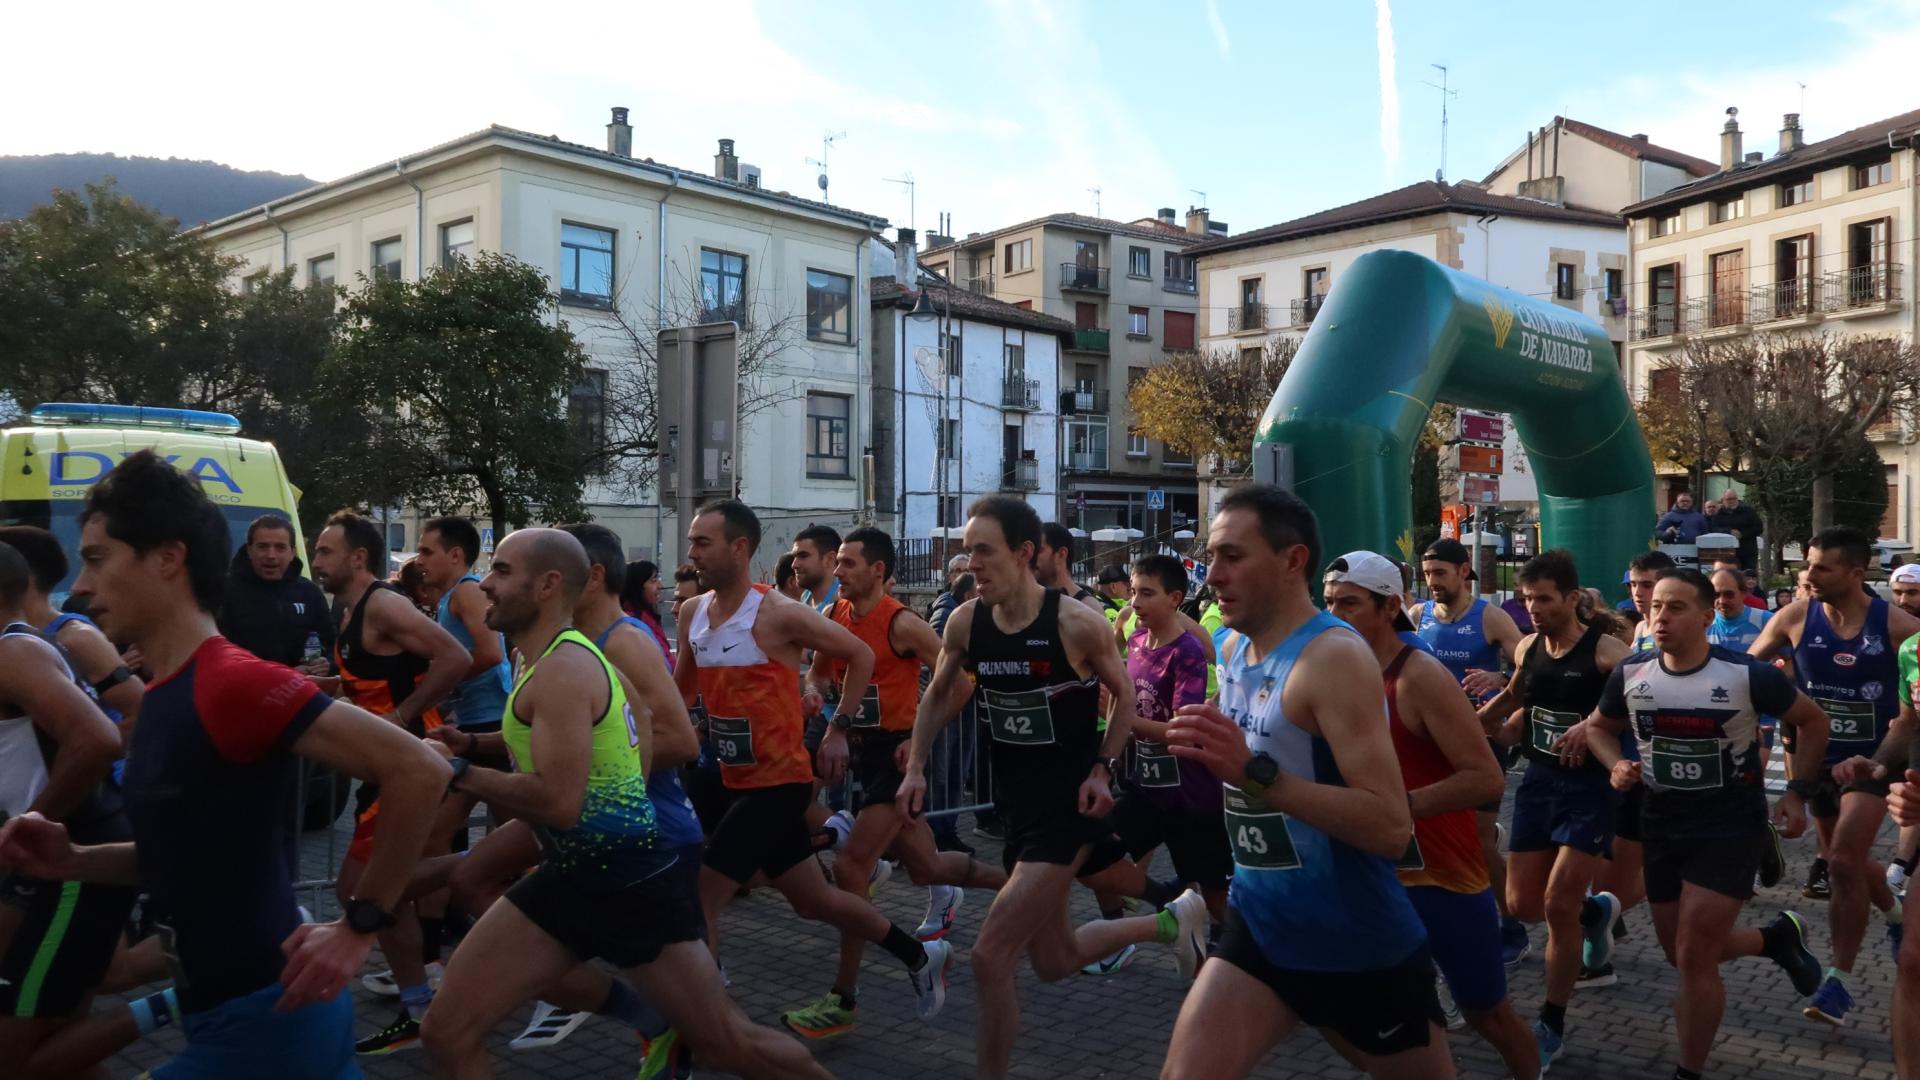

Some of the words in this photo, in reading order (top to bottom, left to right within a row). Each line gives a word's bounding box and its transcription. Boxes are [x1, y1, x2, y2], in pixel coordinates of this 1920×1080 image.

[1519, 304, 1550, 334] CAJA
[1519, 331, 1539, 359] DE
[1539, 337, 1592, 373] NAVARRA
[1436, 650, 1471, 658] RAMOS
[855, 703, 866, 719] 2
[1004, 716, 1033, 734] 42
[1830, 718, 1858, 734] 62
[718, 740, 737, 757] 59
[1142, 762, 1161, 778] 31
[1670, 761, 1703, 780] 89
[1238, 825, 1268, 854] 43
